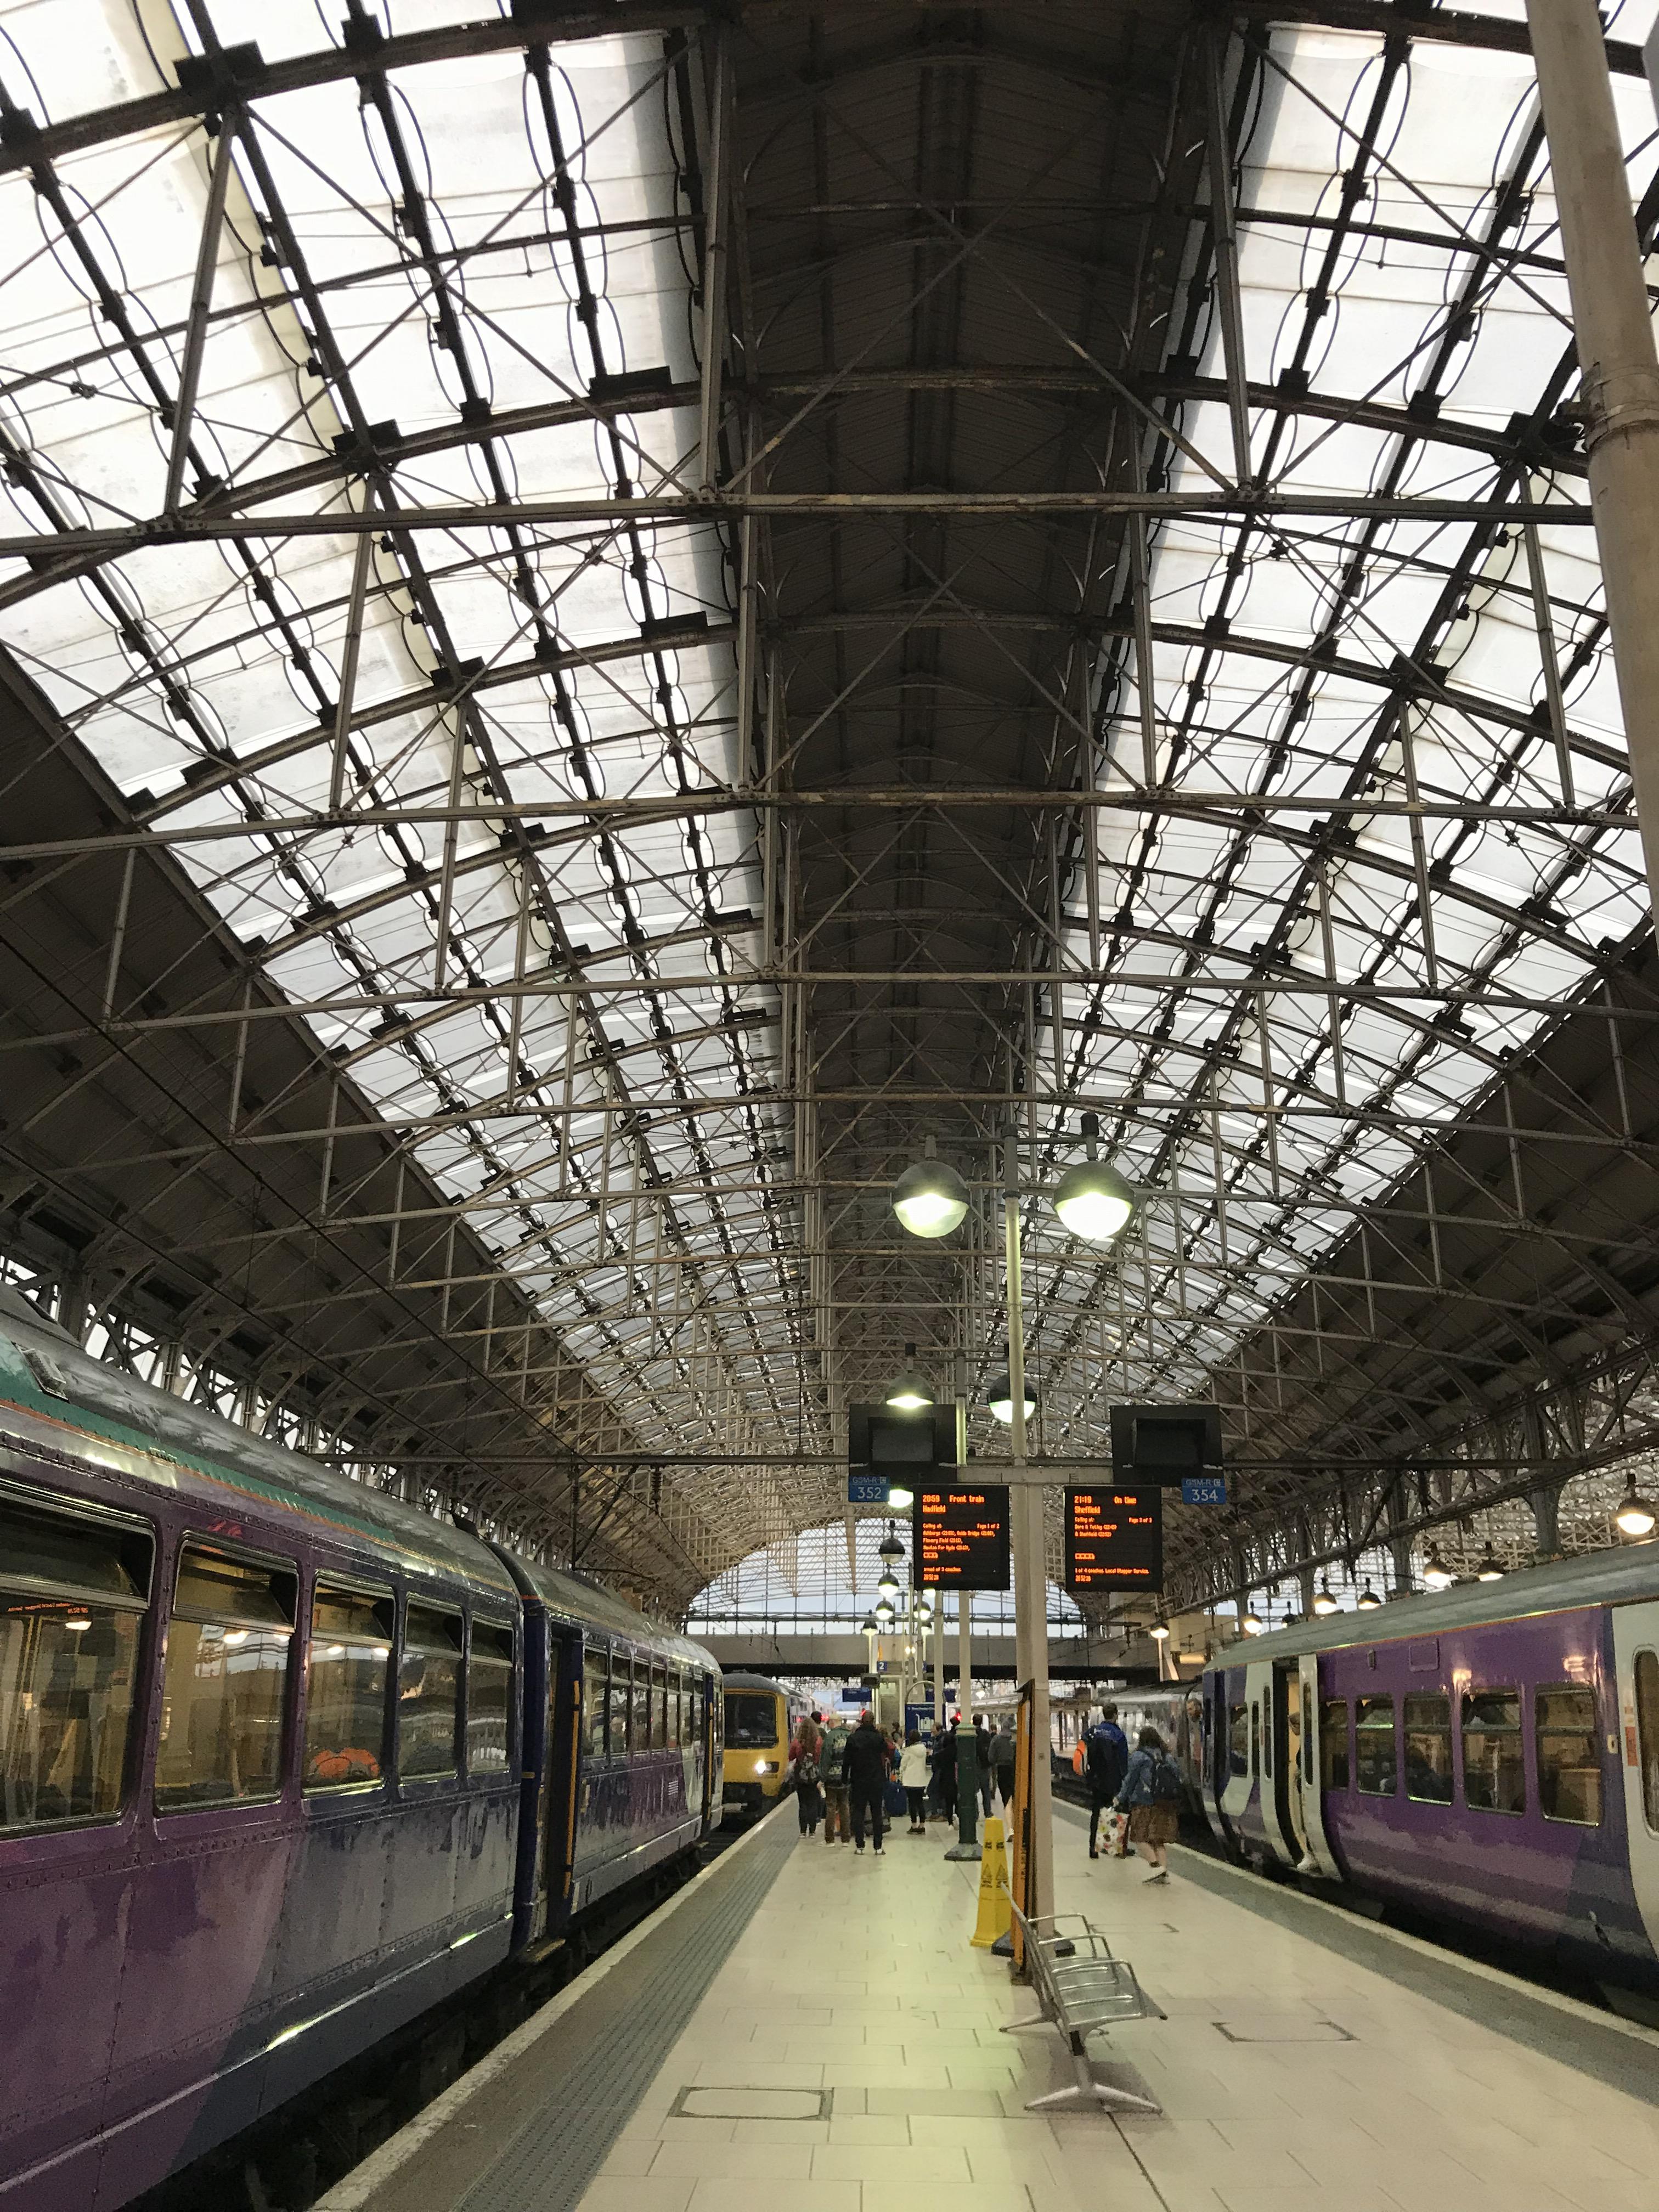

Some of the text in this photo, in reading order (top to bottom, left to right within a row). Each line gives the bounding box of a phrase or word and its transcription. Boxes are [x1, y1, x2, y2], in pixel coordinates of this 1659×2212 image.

[857, 1486, 882, 1499] 352
[1192, 1489, 1218, 1502] 354
[922, 1494, 940, 1503] 20:59
[949, 1494, 967, 1503] Front
[1074, 1496, 1092, 1504] 21:19
[1074, 1505, 1101, 1514] Sheffield
